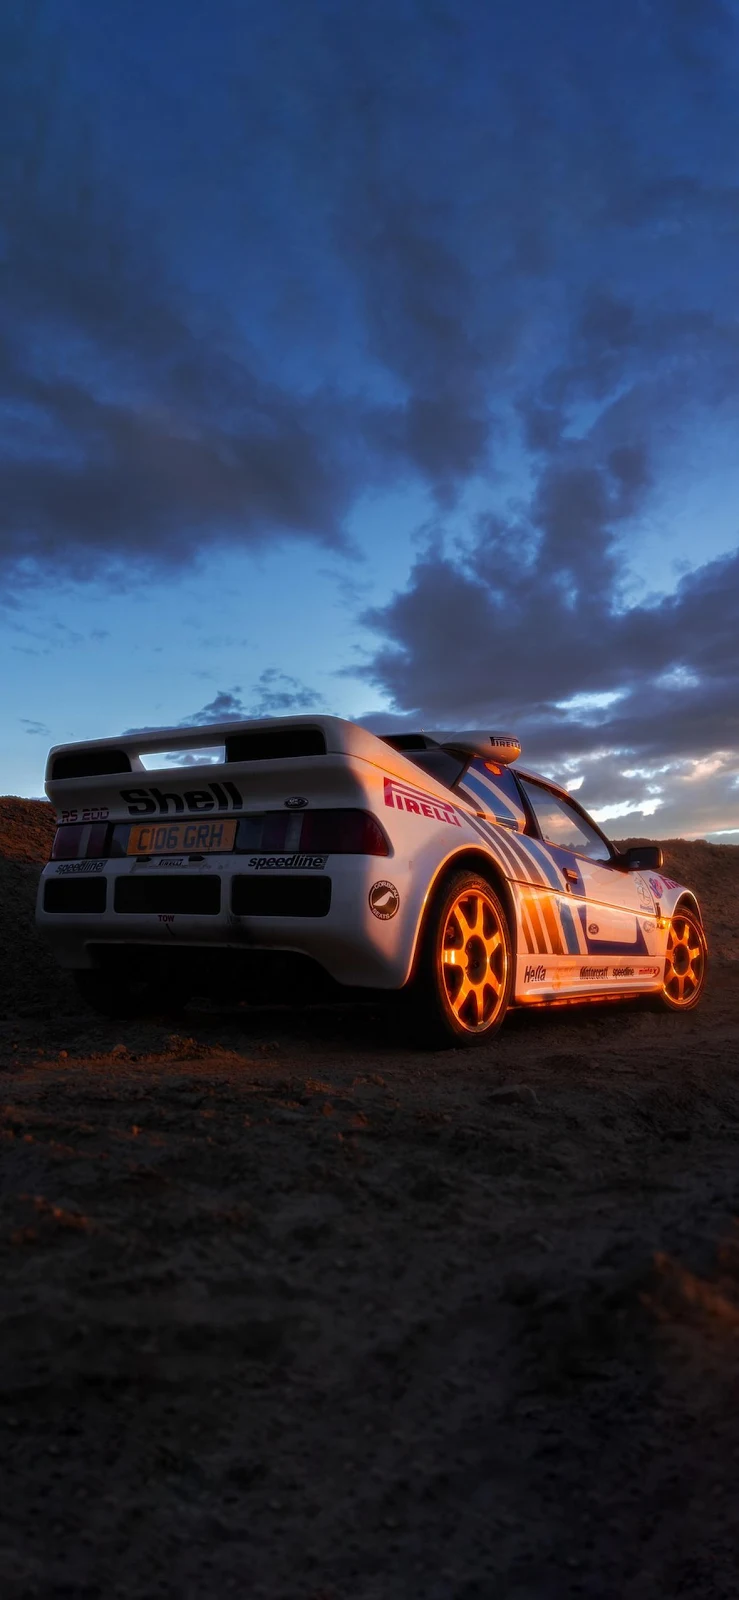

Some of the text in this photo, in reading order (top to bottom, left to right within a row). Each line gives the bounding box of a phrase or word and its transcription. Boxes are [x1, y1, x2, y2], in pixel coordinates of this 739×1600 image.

[489, 736, 520, 749] PIRELLI
[120, 782, 243, 816] Shell
[383, 776, 462, 827] PIRELLI
[61, 807, 110, 822] RS 200
[137, 824, 224, 851] C106 GRH
[55, 860, 104, 875] speedline
[158, 858, 184, 866] PIRELLI
[248, 854, 325, 870] speedline
[523, 965, 547, 983] Hella
[579, 966, 608, 980] Motorcraft
